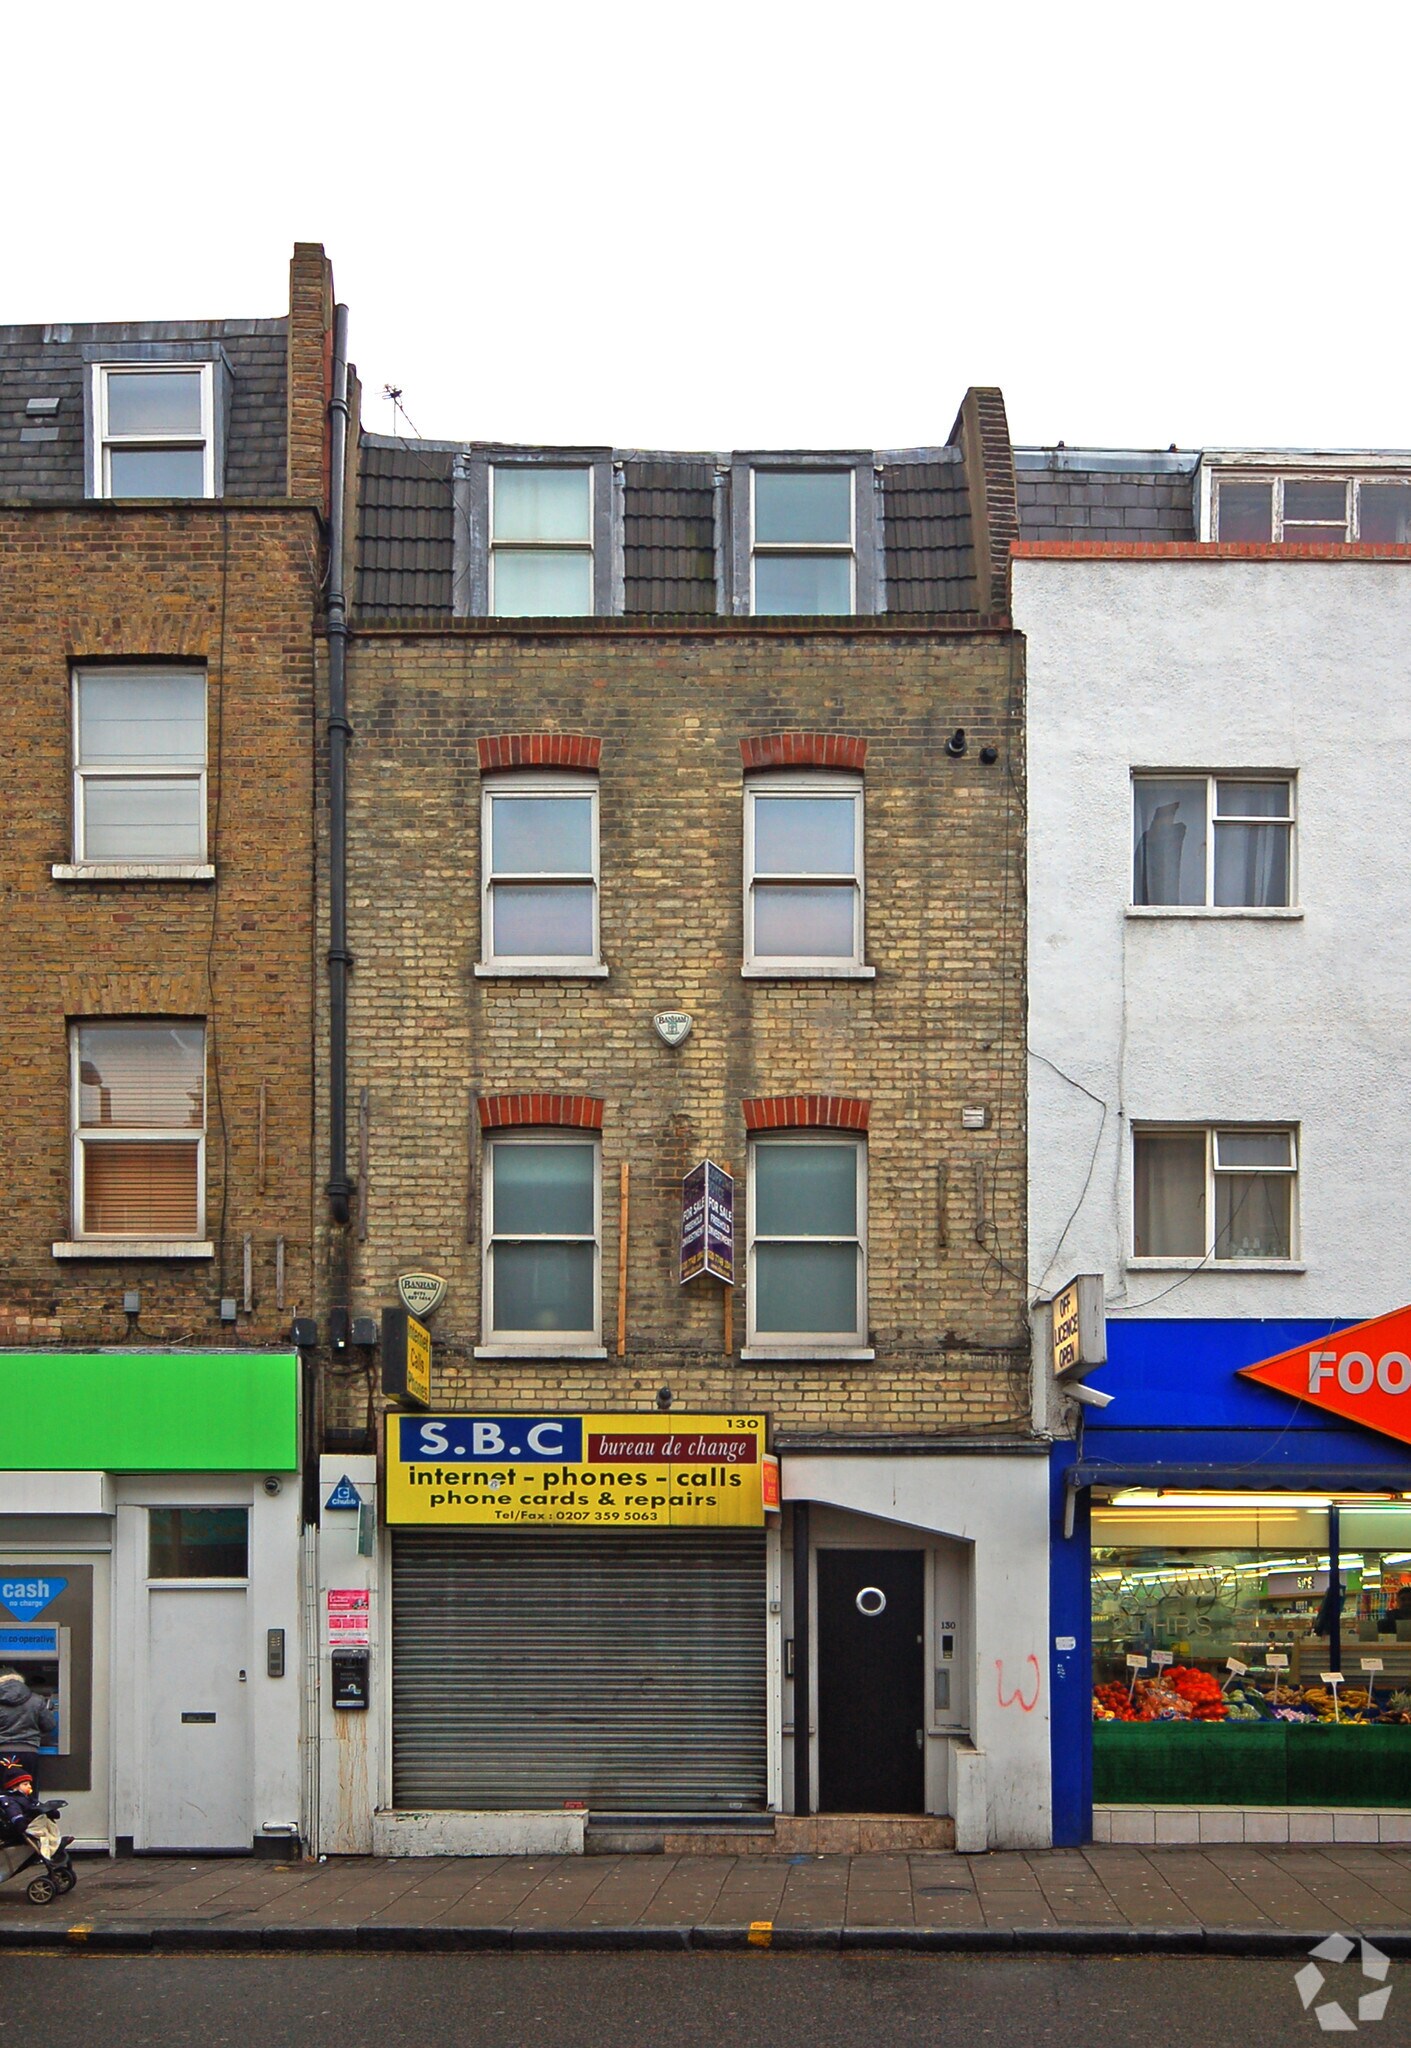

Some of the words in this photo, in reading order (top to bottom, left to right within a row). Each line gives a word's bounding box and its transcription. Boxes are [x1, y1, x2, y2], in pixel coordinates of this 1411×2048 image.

[683, 1205, 693, 1222] FOR
[693, 1196, 705, 1214] SALE
[708, 1196, 718, 1213] FOR
[719, 1204, 732, 1222] SALE
[404, 1280, 437, 1290] BANHAM
[1060, 1293, 1071, 1317] OFF
[1054, 1313, 1078, 1347] LICENCE
[1059, 1342, 1075, 1368] OPEN
[1308, 1351, 1411, 1395] FOO
[726, 1419, 759, 1429] 130
[419, 1422, 563, 1455] S.B.C
[599, 1436, 655, 1456] bureau
[661, 1436, 681, 1456] de
[687, 1436, 747, 1462] change
[409, 1466, 516, 1486] internet
[544, 1466, 648, 1490] phones
[676, 1467, 742, 1487] calls
[430, 1490, 512, 1508] phone
[519, 1491, 589, 1505] cards
[597, 1492, 616, 1506] &
[624, 1492, 717, 1509] repairs
[494, 1510, 545, 1521] Tel/Fax
[556, 1511, 590, 1520] 0207
[594, 1511, 620, 1520] 359
[623, 1511, 658, 1521] 5063
[2, 1579, 50, 1598] cash
[941, 1621, 956, 1629] 130
[1153, 1615, 1213, 1637] HRS
